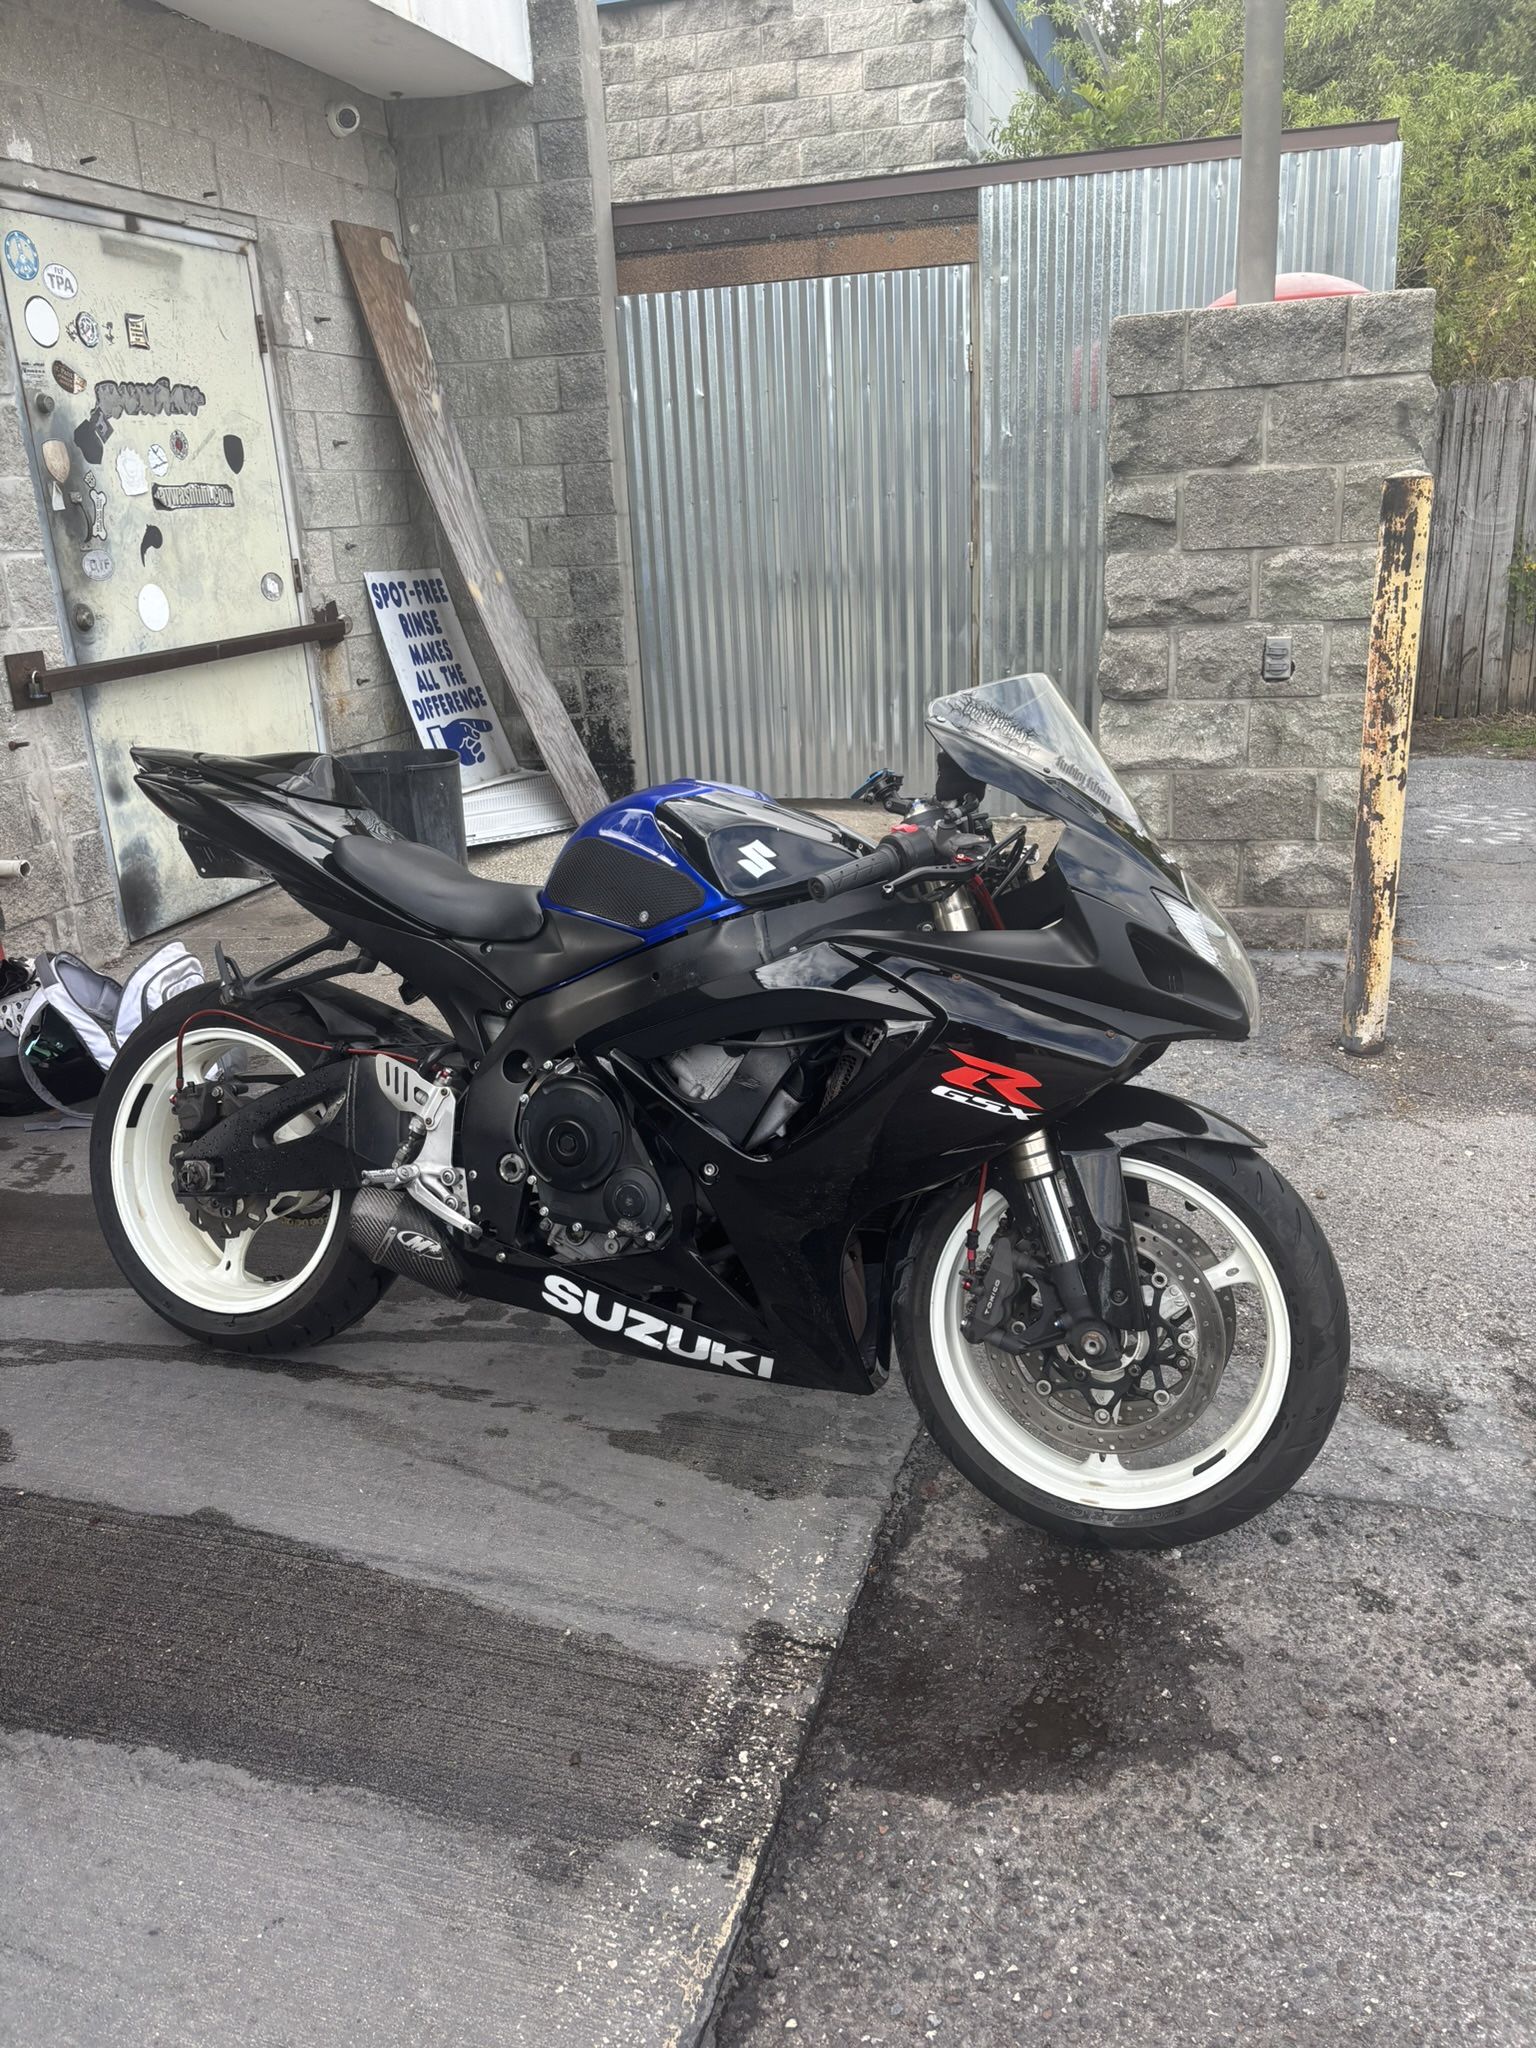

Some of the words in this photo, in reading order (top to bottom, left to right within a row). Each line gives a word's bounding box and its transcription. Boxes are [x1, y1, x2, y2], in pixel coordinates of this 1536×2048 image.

[47, 272, 74, 293] TPA
[371, 578, 449, 610] SPOT-FREE
[398, 610, 443, 639] RINSE
[408, 639, 453, 666] MAKES
[415, 669, 440, 693] ALL
[440, 663, 467, 686] THE
[412, 686, 487, 721] DIFFERENCE
[931, 1085, 1043, 1121] GSX
[541, 1274, 775, 1379] SUZUKI
